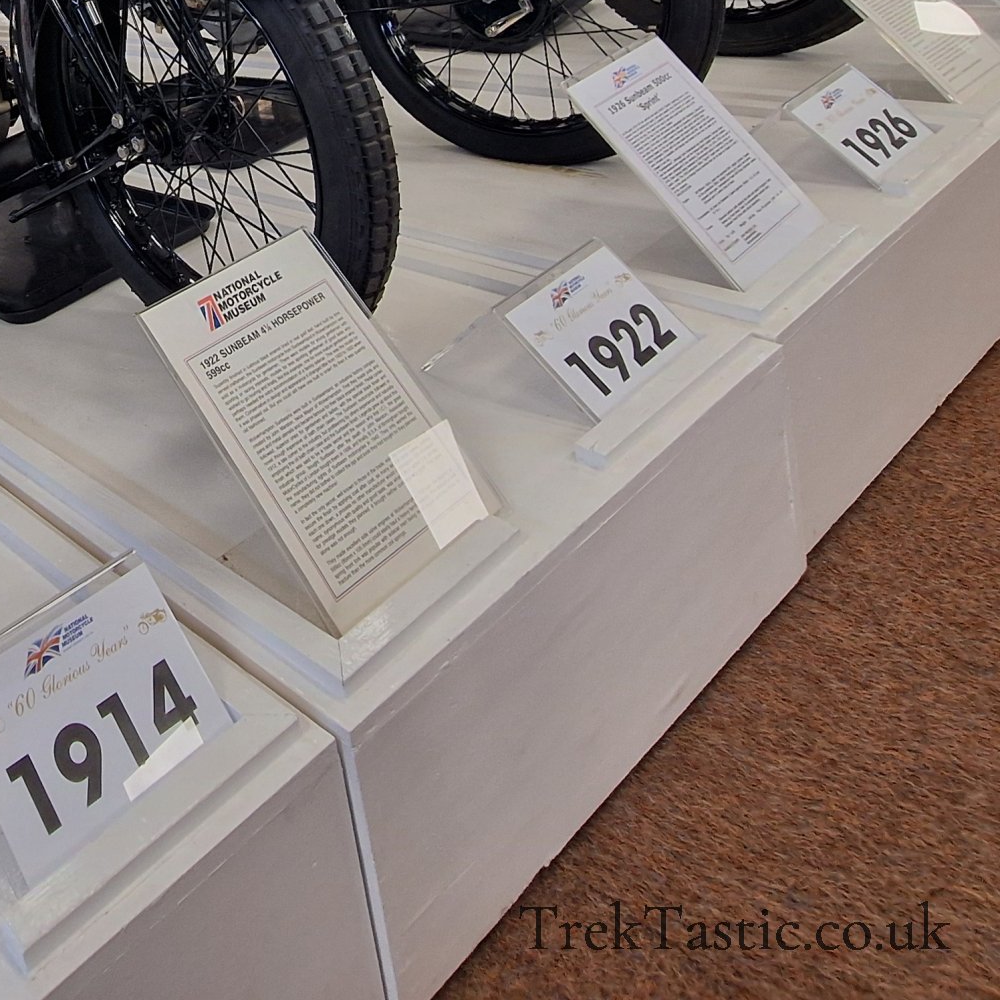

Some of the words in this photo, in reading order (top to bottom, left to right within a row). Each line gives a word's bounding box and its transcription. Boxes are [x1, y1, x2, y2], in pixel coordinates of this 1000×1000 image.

[841, 108, 918, 167] 1926
[213, 270, 262, 301] NATIONAL
[218, 270, 283, 312] MOTORCYCLE
[223, 292, 267, 323] MUSEUM
[200, 353, 221, 370] 1922
[219, 329, 261, 359] SUNBEAM
[270, 291, 326, 329] HORSEPOWER
[563, 304, 678, 397] 1922
[205, 362, 231, 380] 599cc
[41, 660, 91, 699] Glorious
[5, 658, 199, 836] 1914
